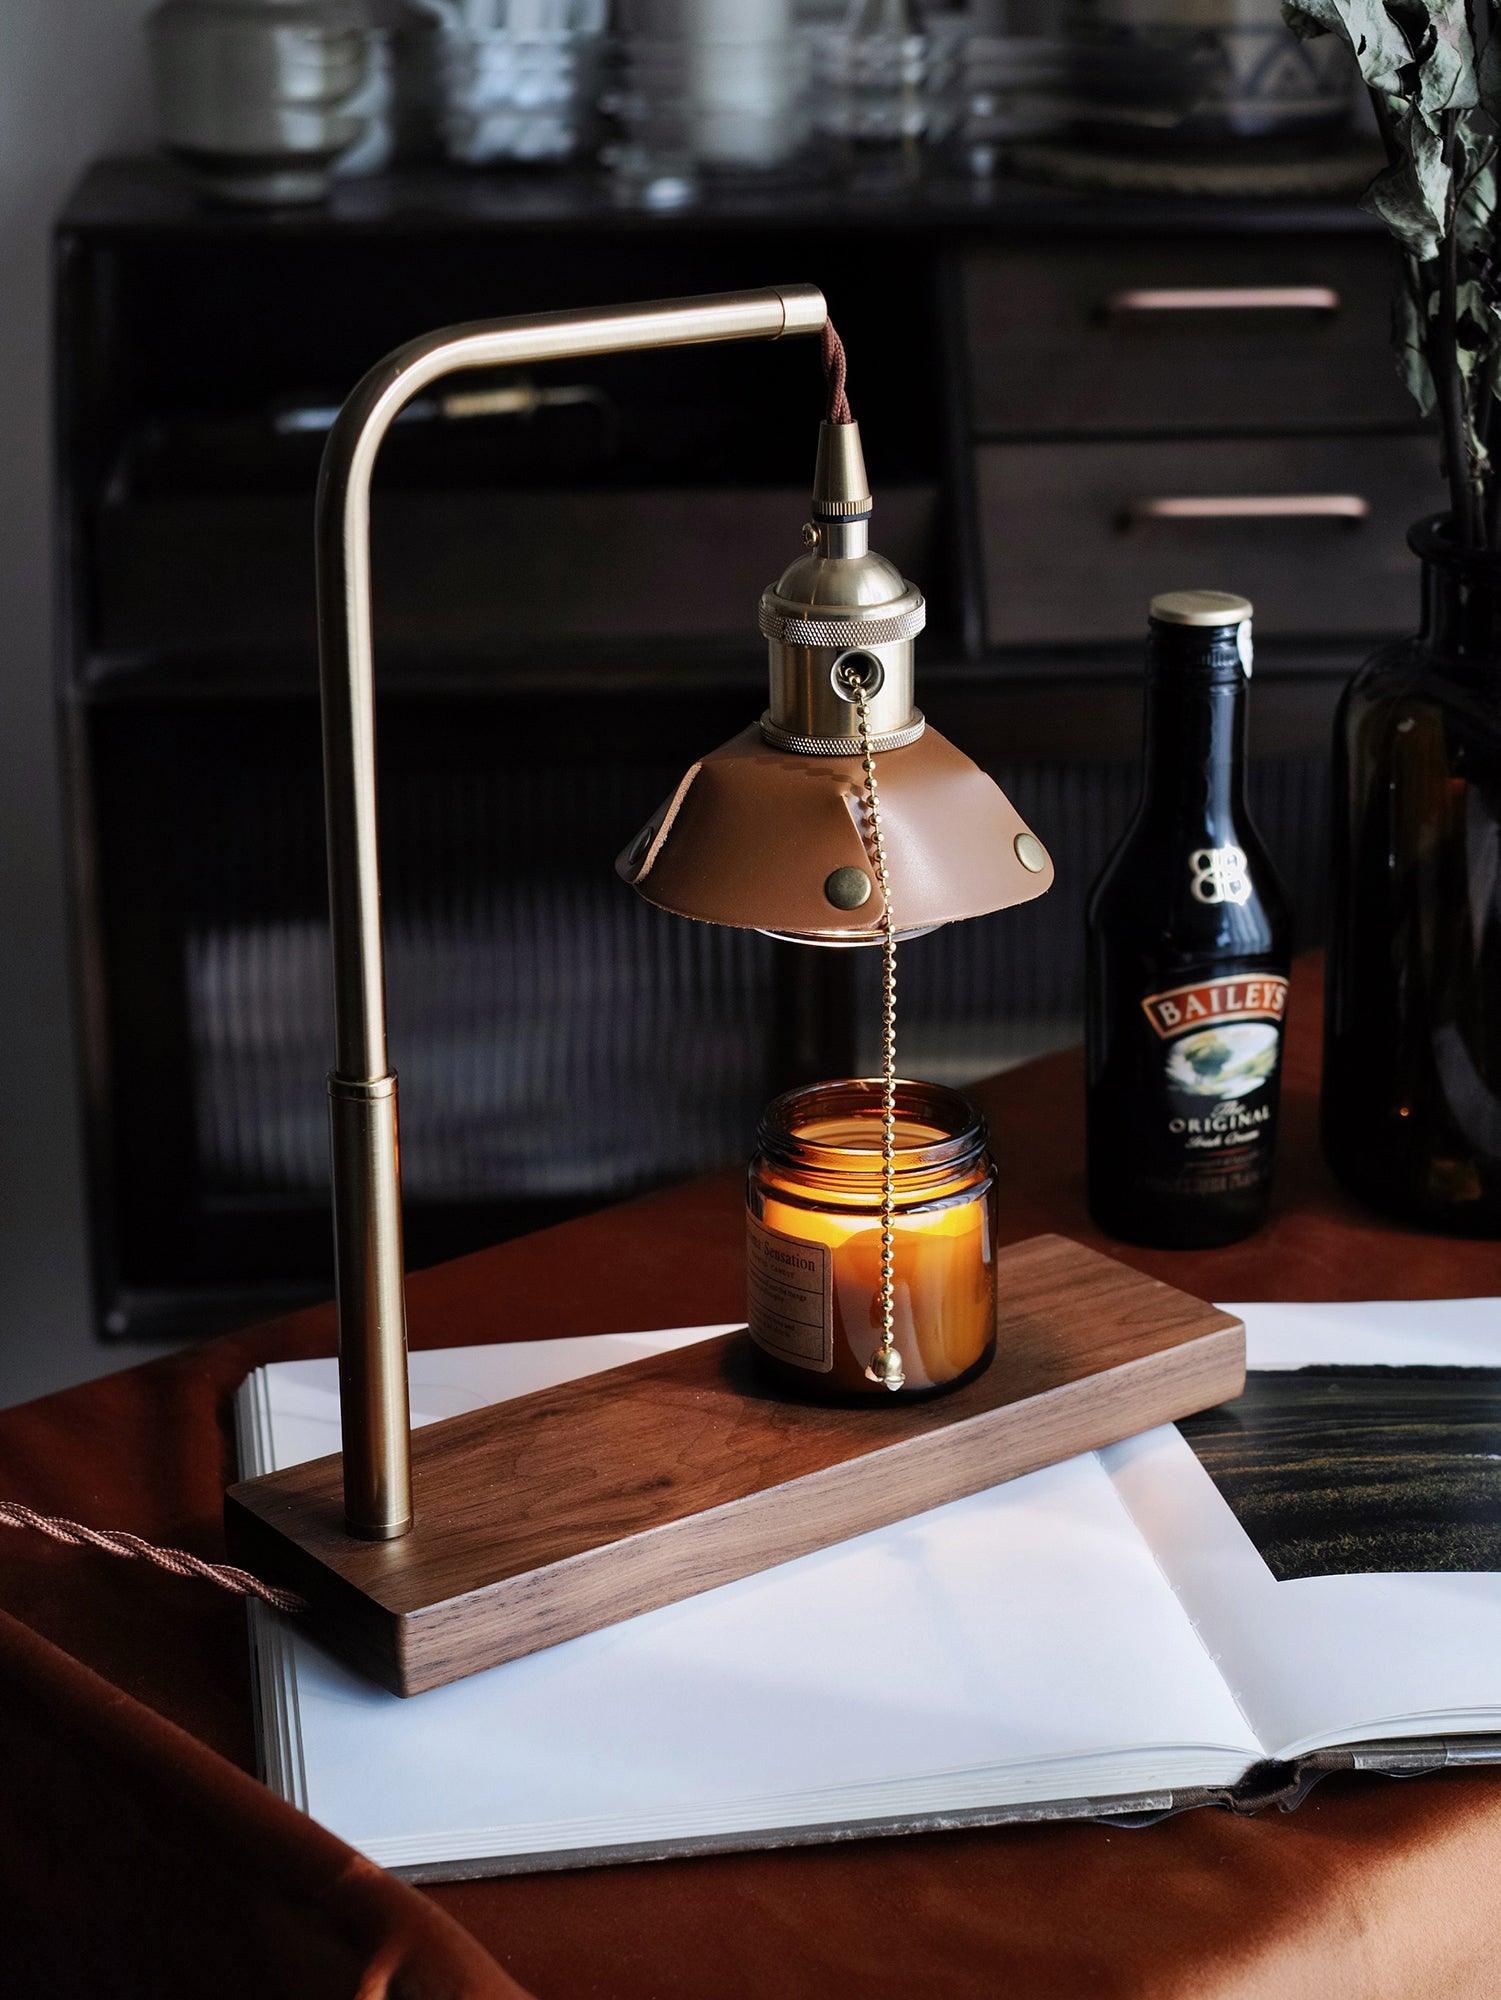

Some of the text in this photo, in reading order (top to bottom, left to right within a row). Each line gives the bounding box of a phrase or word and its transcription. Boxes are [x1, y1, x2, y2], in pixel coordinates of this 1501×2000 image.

[1157, 981, 1287, 1027] BAILEYS
[1168, 1104, 1271, 1134] ORIGINAL
[763, 1239, 816, 1272] Sensation
